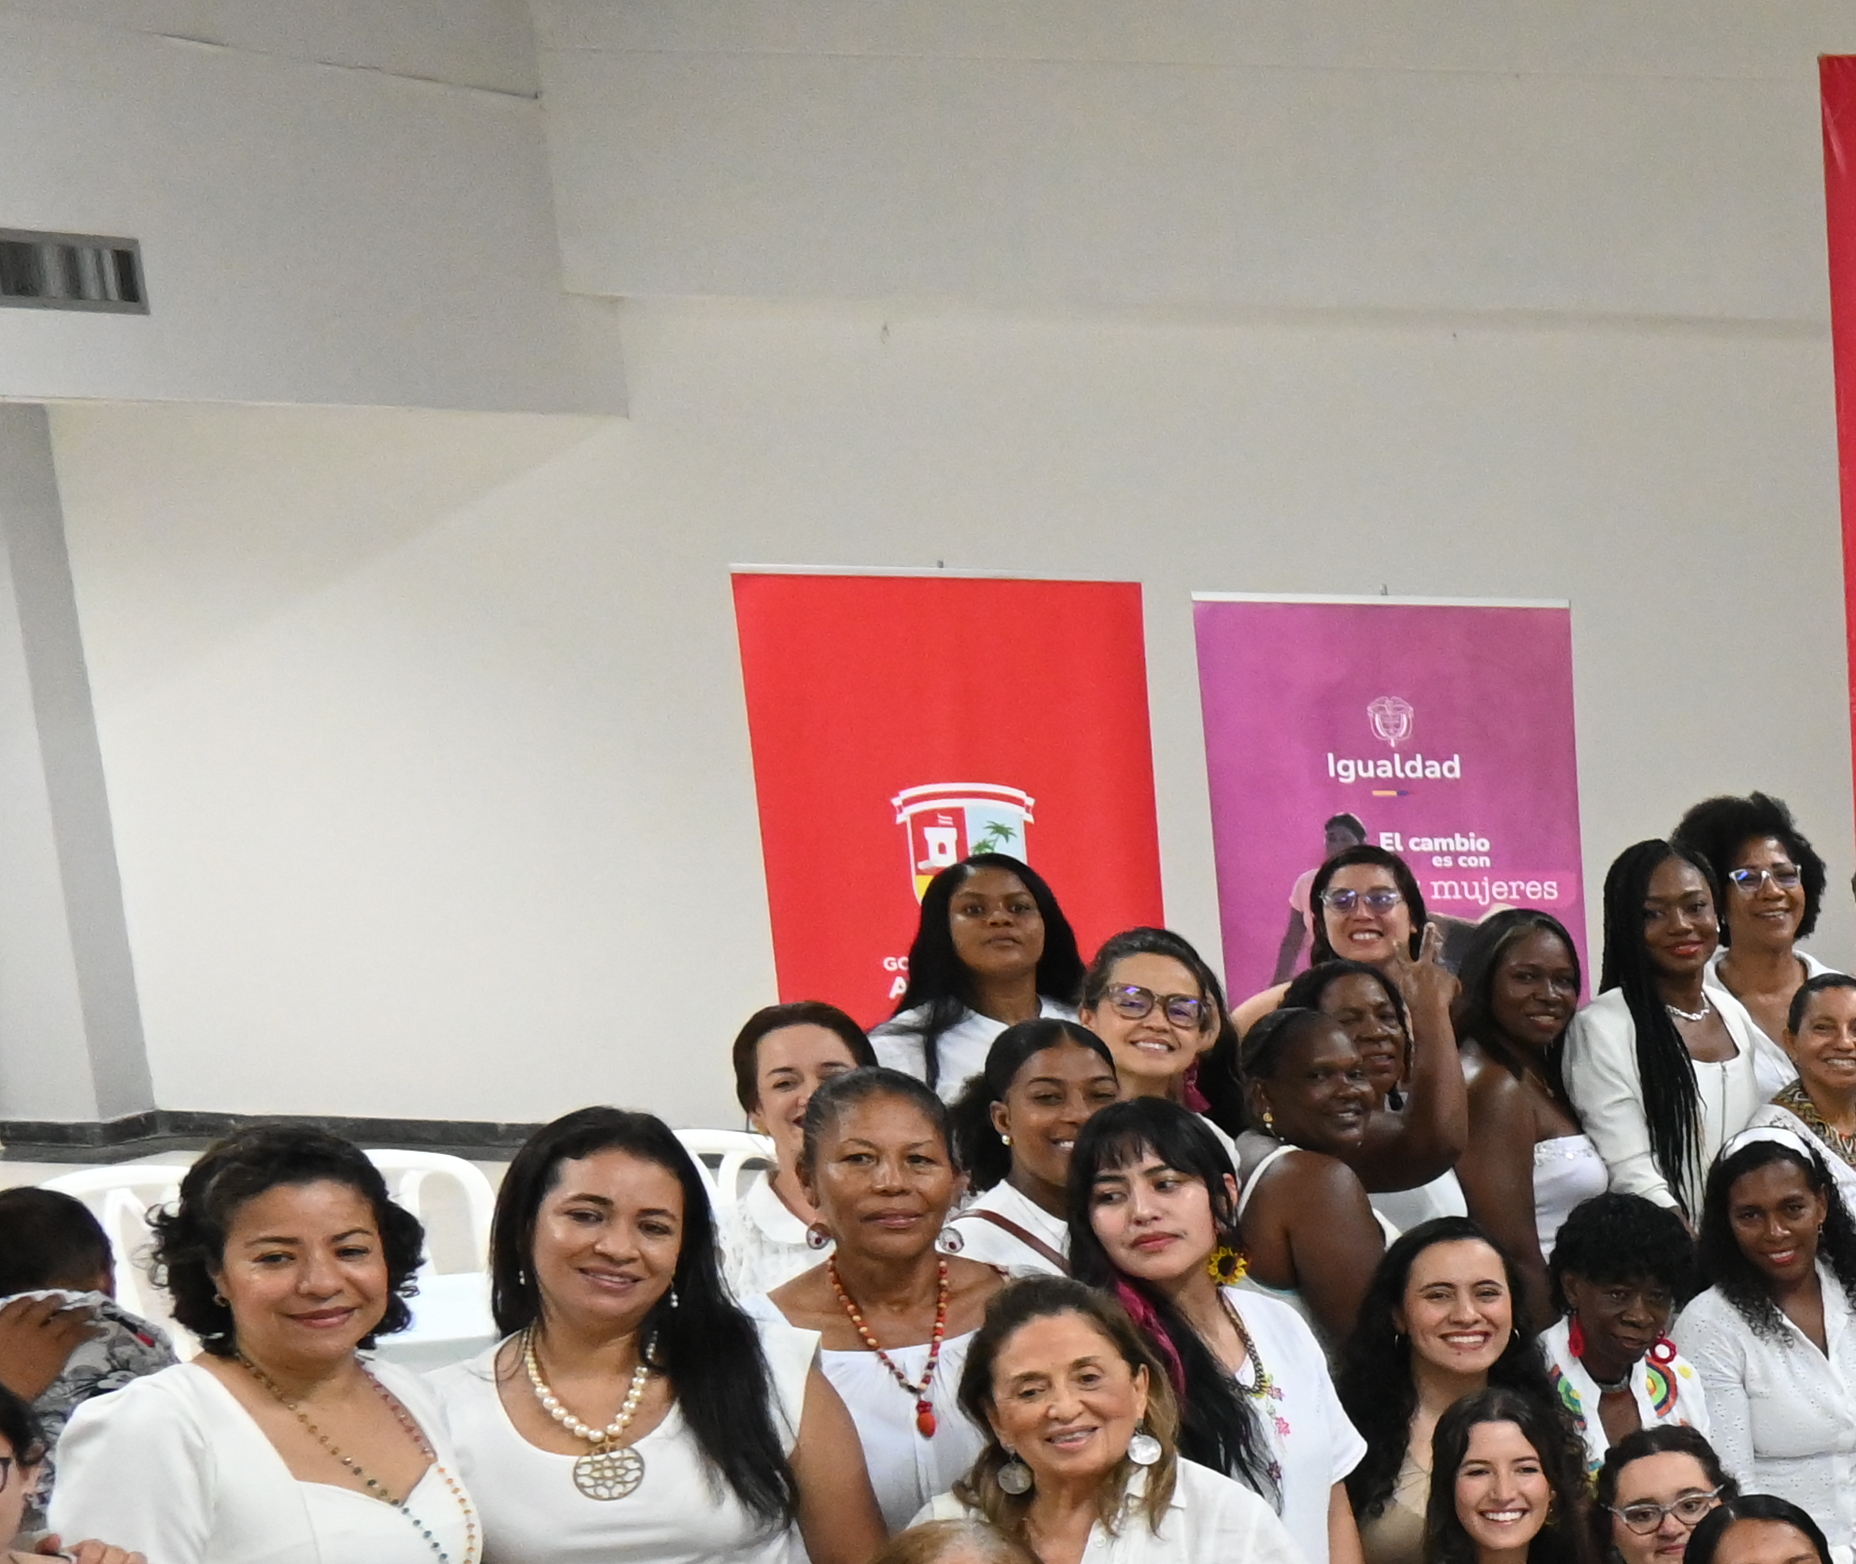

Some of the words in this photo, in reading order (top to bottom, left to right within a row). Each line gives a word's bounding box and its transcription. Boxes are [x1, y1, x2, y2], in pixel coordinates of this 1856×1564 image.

[1327, 753, 1462, 783] Igualdad
[1379, 832, 1403, 852] El
[1409, 832, 1491, 852] cambio
[1432, 856, 1453, 867] es
[1458, 856, 1491, 868] con
[1430, 876, 1559, 906] mujeres
